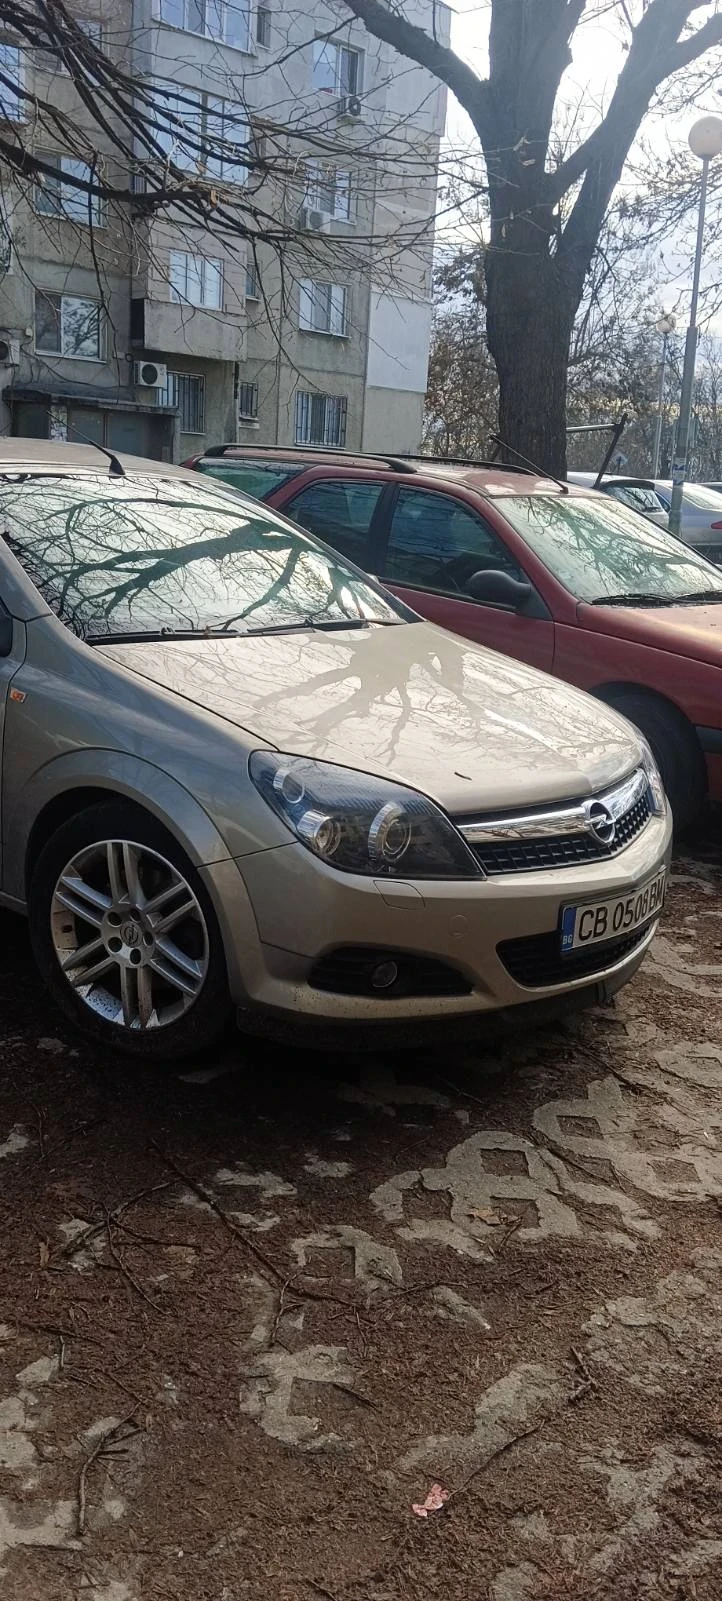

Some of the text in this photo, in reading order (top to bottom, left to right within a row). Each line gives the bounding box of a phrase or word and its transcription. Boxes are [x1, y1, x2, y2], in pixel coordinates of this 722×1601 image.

[579, 906, 608, 941] CB
[612, 889, 649, 932] 0508
[562, 934, 573, 945] BG
